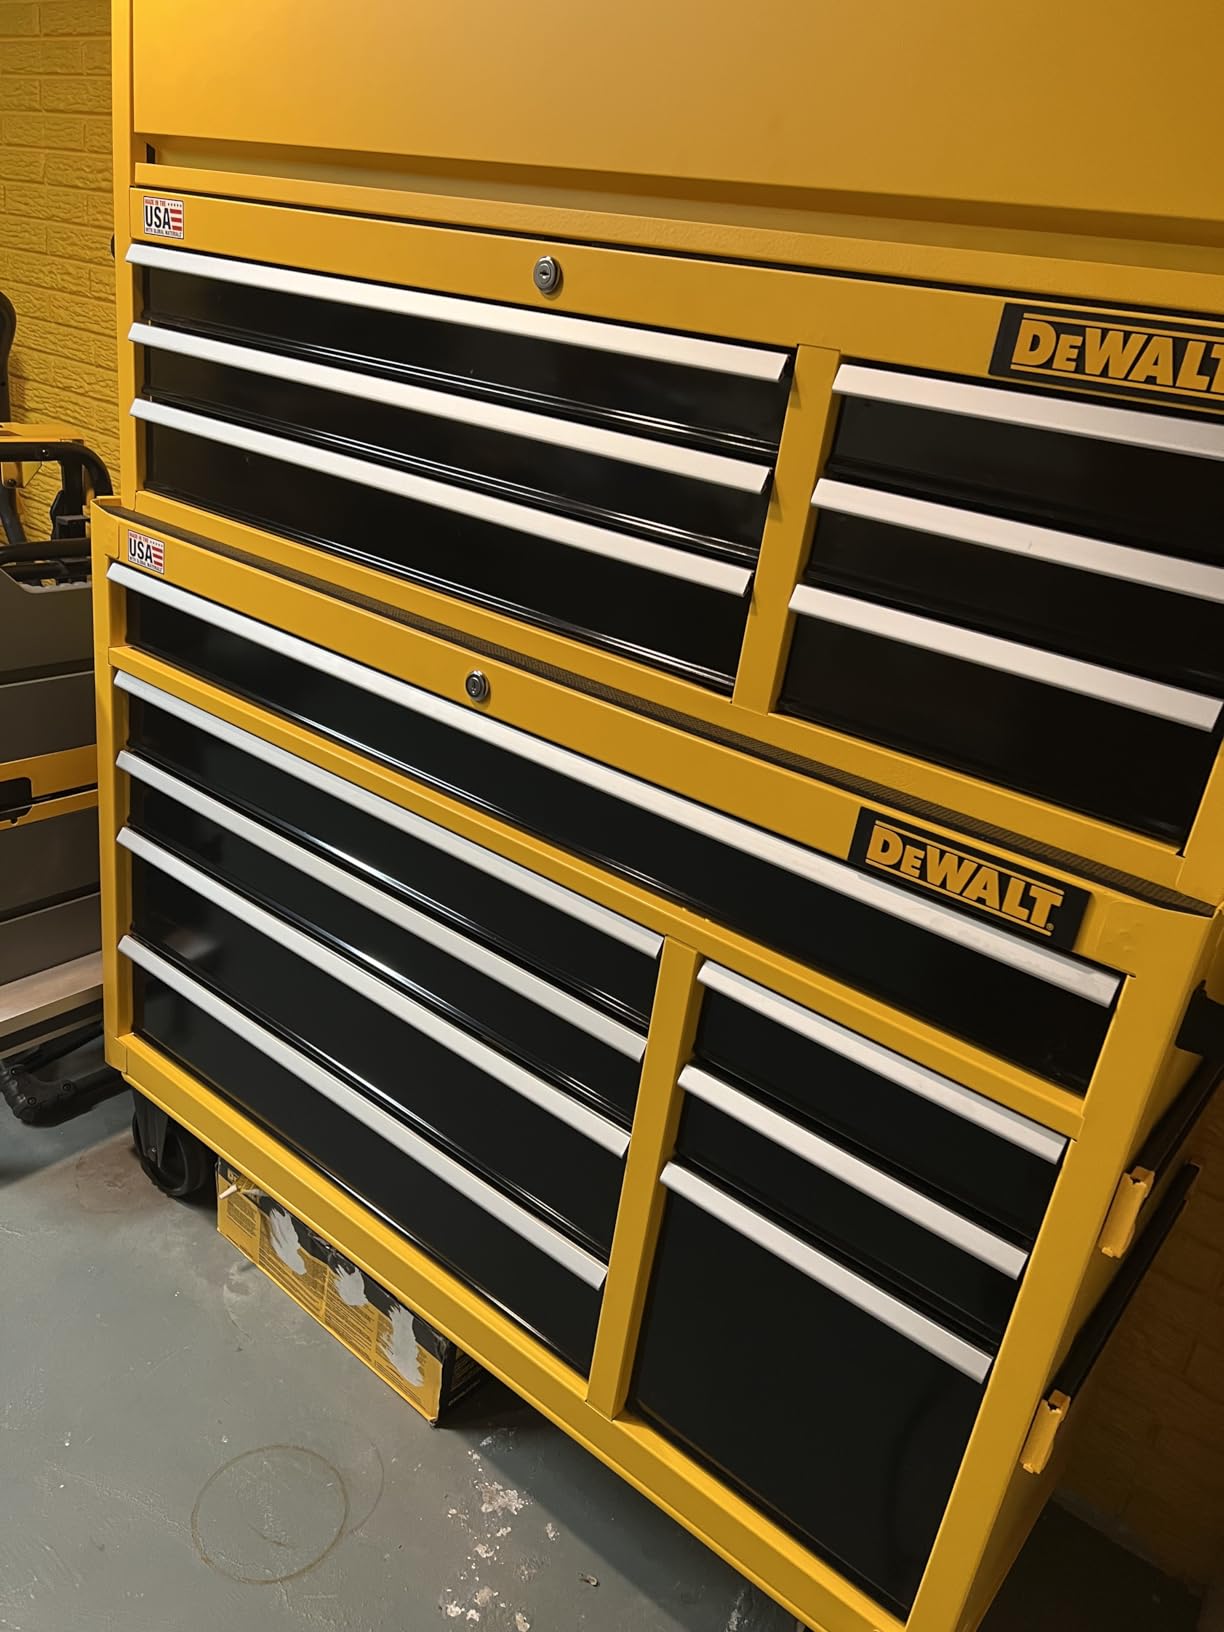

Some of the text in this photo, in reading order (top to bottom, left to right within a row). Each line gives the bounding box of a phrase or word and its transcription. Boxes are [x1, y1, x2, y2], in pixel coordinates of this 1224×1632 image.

[145, 205, 171, 230] USA
[130, 538, 153, 564] USA
[865, 824, 1064, 929] DEWALT
